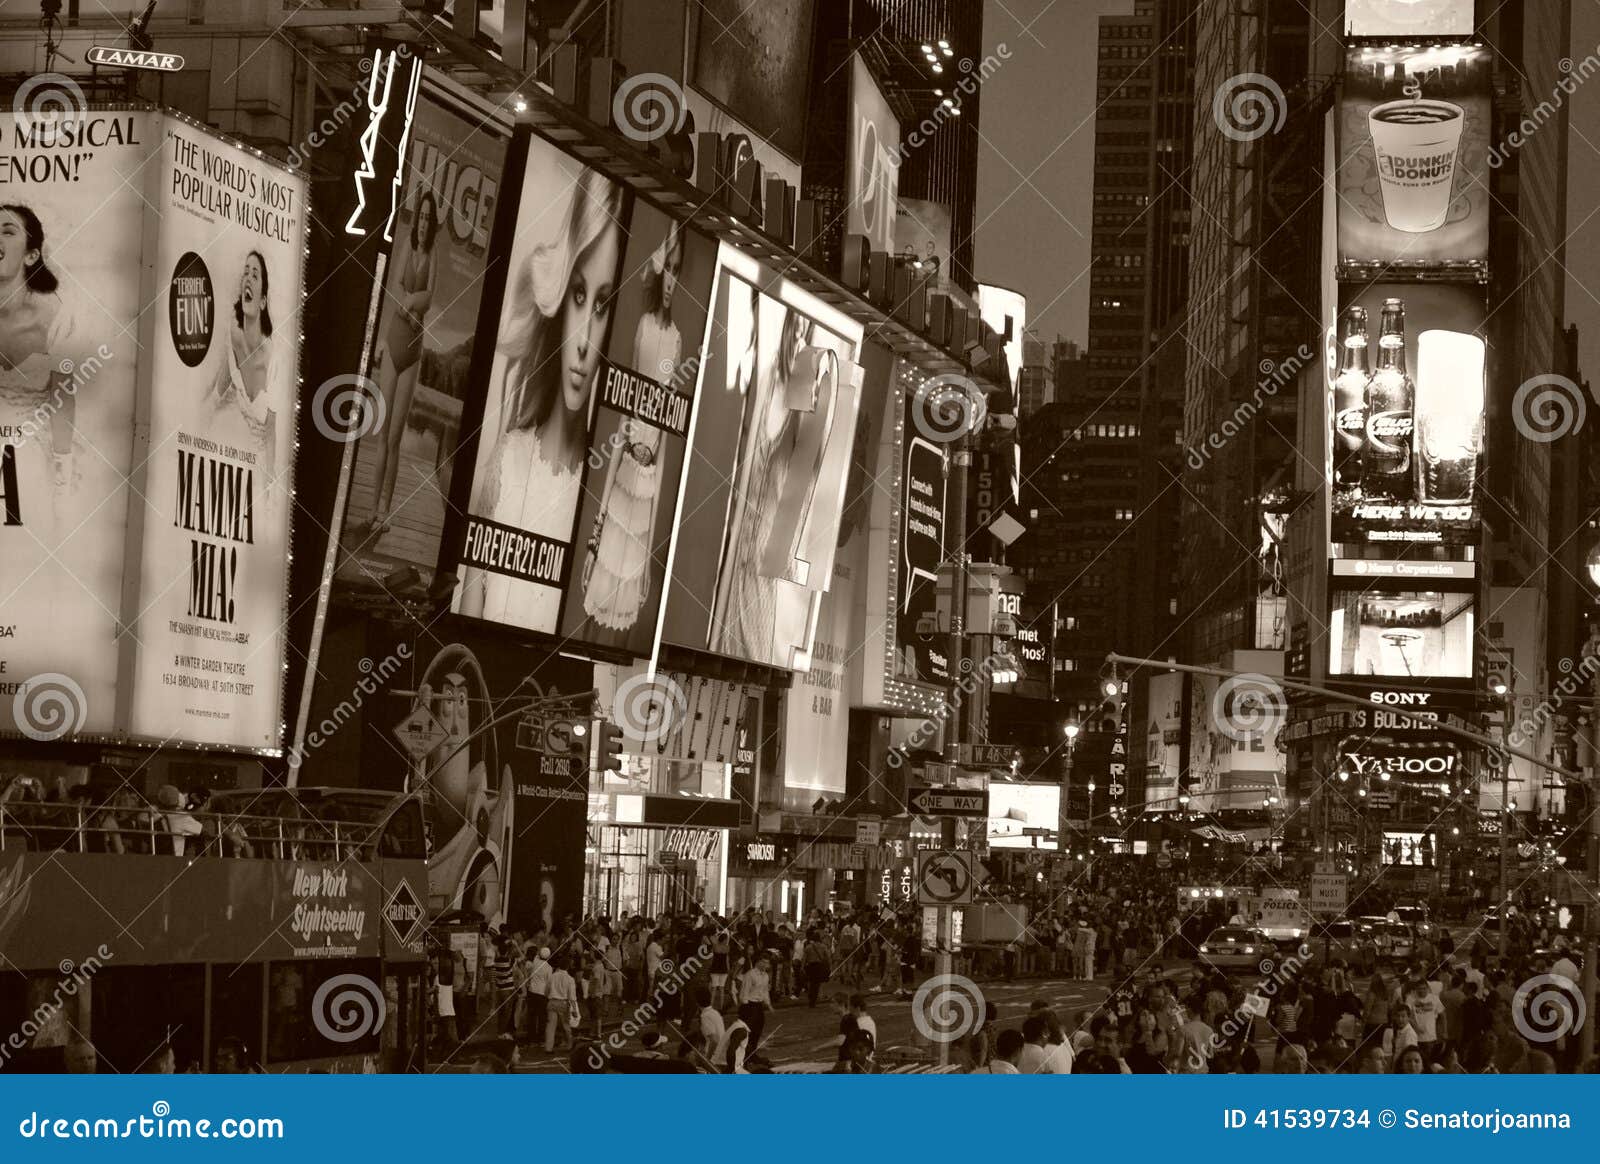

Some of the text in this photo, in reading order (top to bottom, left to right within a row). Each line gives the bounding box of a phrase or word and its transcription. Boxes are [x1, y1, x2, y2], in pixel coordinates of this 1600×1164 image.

[95, 49, 175, 69] LAMAR
[14, 117, 140, 149] MUSICAL
[1395, 162, 1452, 179] DONUTS
[173, 168, 231, 220] POPULAR
[261, 177, 294, 213] MOST
[404, 138, 498, 250] HUGE
[604, 366, 688, 432] FOREVER21.COM
[174, 449, 254, 545] MAMMA
[977, 454, 992, 526] 1500
[1352, 505, 1473, 520] HERE WE GO
[463, 520, 565, 583] FOREVER21.COM
[1368, 562, 1454, 575] News Corporation
[187, 539, 237, 624] MIA!
[1018, 629, 1038, 642] met
[180, 656, 201, 669] WINTER
[202, 659, 222, 672] GARDEN
[162, 673, 254, 696] 1634 BROADWAY AT 50TH STREET
[819, 697, 832, 716] BAR
[1370, 691, 1431, 705] SONY
[975, 747, 984, 762] W
[1344, 752, 1454, 775] YAHOO!
[541, 756, 570, 776] Fall 2010
[920, 796, 979, 808] ONE WAY
[747, 843, 775, 861] SWAROVSKI
[292, 867, 348, 897] New York
[1319, 889, 1338, 897] MUST
[390, 904, 417, 920] GRAY LINE
[1263, 900, 1299, 910] POLICE
[291, 903, 366, 942] Sightseeing
